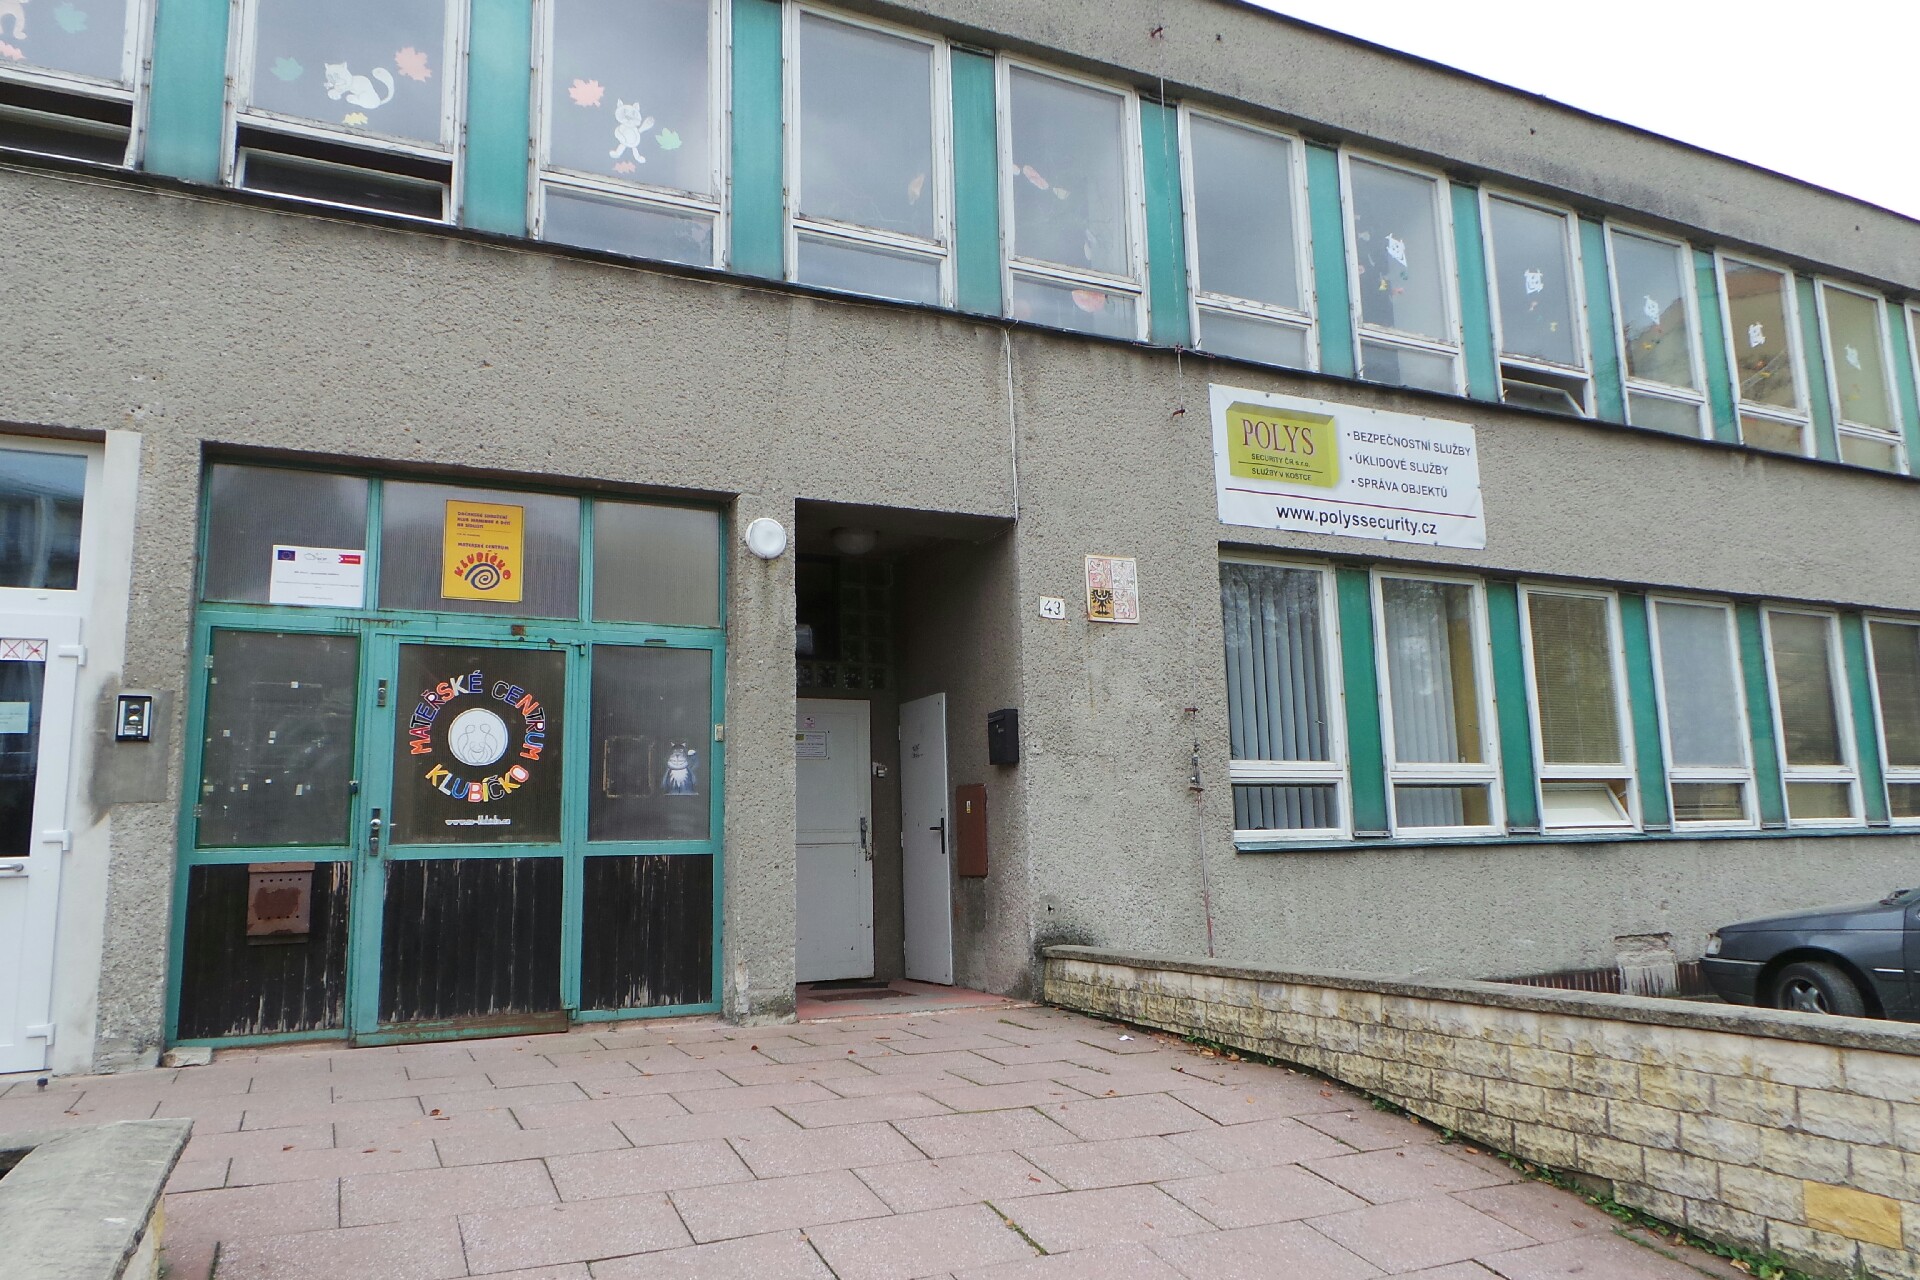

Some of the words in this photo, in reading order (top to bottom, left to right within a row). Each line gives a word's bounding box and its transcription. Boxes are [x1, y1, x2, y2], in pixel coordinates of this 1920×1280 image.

[1241, 418, 1315, 456] POLYS
[1353, 430, 1431, 452] BEZPEČNOSTNÍ
[1433, 442, 1471, 457] SLUŽBY
[1251, 453, 1283, 464] SECURITY
[1285, 456, 1294, 465] ČR
[1251, 467, 1278, 477] SLUŽBY
[1355, 452, 1407, 471] ÚKLIDOVÉ
[1410, 461, 1449, 476] SLUŽBY
[1357, 477, 1399, 492] SPRÁVA
[1401, 482, 1448, 498] OBJEKTŮ
[1276, 506, 1437, 536] www.polyssecurity.cz
[454, 550, 511, 580] KLUBÍČKO
[1044, 600, 1060, 615] 43
[409, 669, 484, 756] MATEŘSKÉ
[491, 680, 546, 761] CENTRUM
[424, 763, 530, 803] KLUBÍČKO
